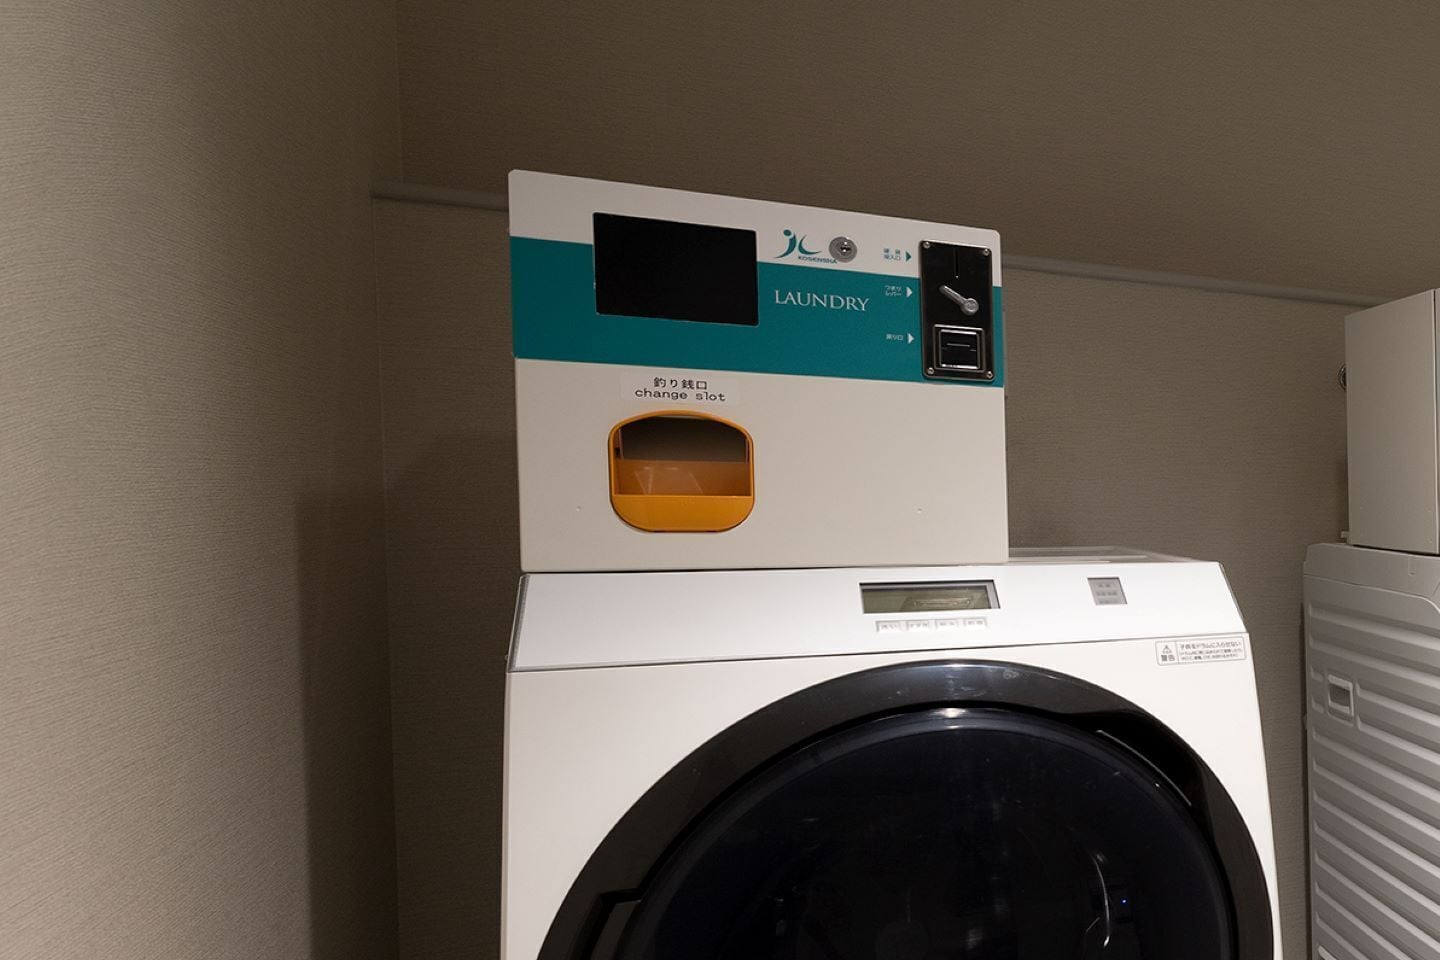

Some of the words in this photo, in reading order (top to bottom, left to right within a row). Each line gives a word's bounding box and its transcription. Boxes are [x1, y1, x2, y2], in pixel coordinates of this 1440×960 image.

[775, 289, 870, 312] LAUNDRY
[653, 377, 707, 390] 釣り銭口
[635, 388, 688, 400] change
[695, 391, 726, 402] slot
